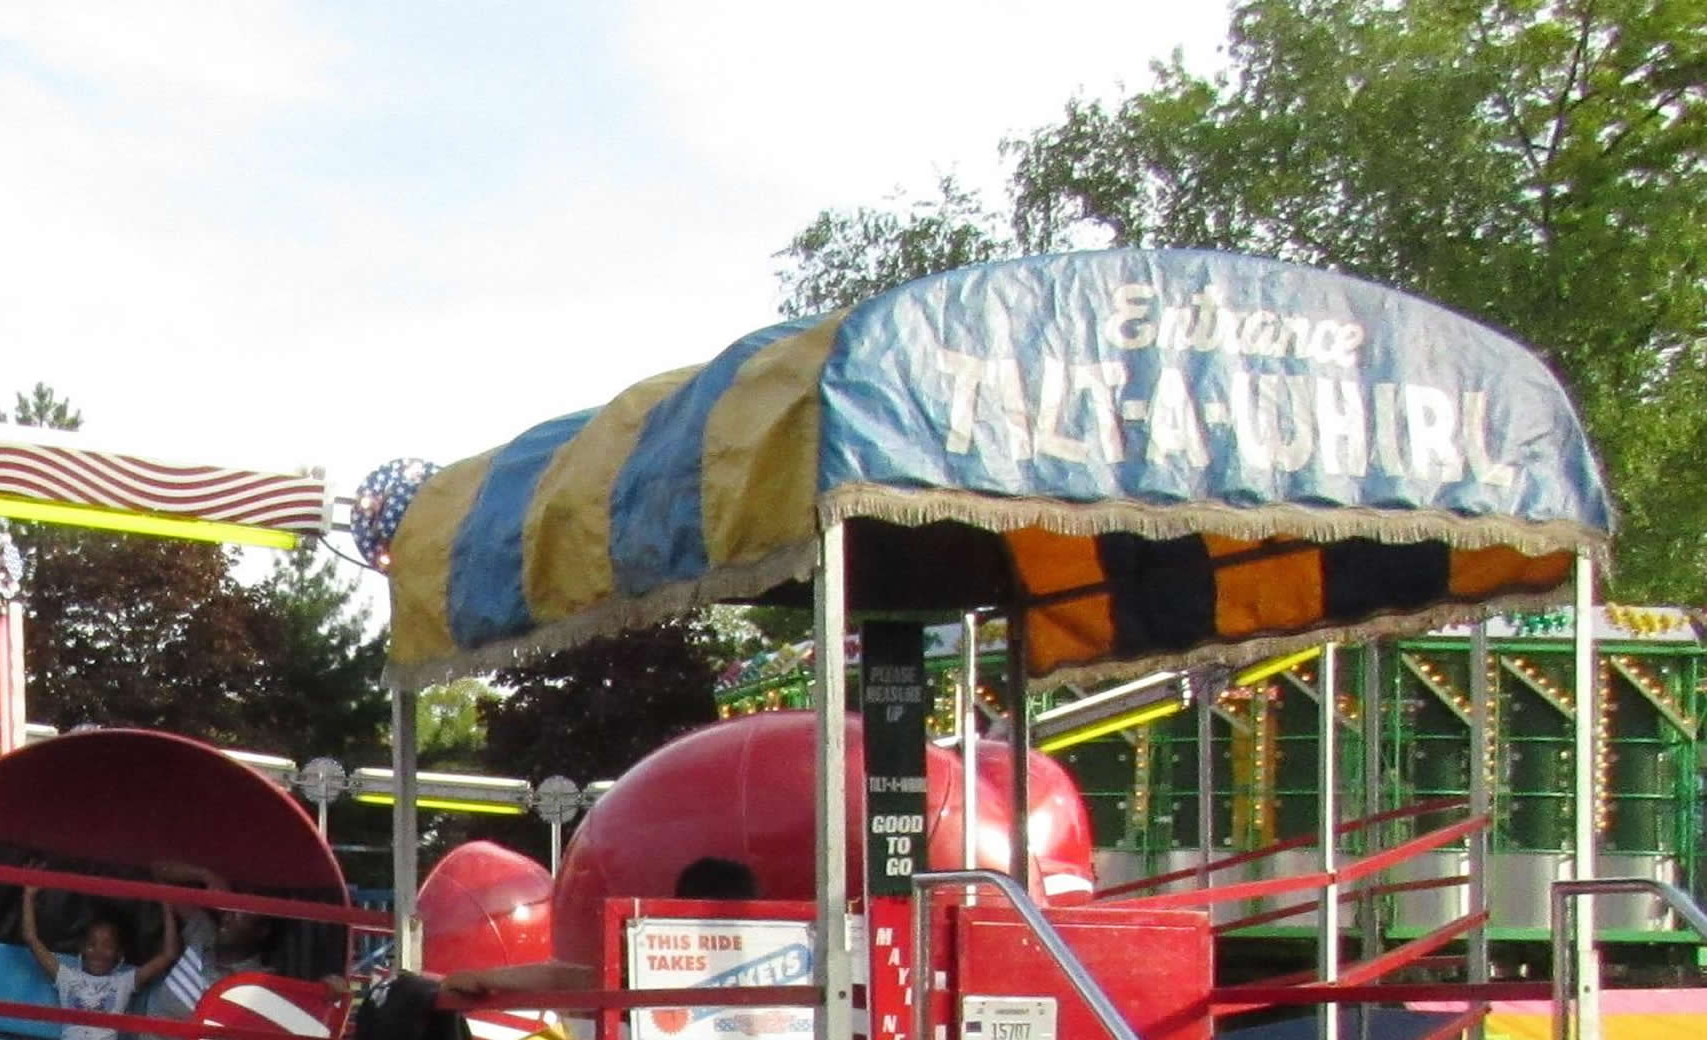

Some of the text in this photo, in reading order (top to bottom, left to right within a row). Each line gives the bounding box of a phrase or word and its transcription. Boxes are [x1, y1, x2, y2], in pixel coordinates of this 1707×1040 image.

[1104, 284, 1365, 368] Entrance
[937, 347, 1516, 488] TILT-A-WHIRL
[866, 685, 923, 703] MEASURE
[886, 704, 904, 722] UP
[871, 815, 924, 834] GOOD
[886, 836, 912, 855] TO
[886, 858, 912, 877] GO
[646, 935, 743, 951] THIS RIDE
[647, 955, 707, 971] TAKES
